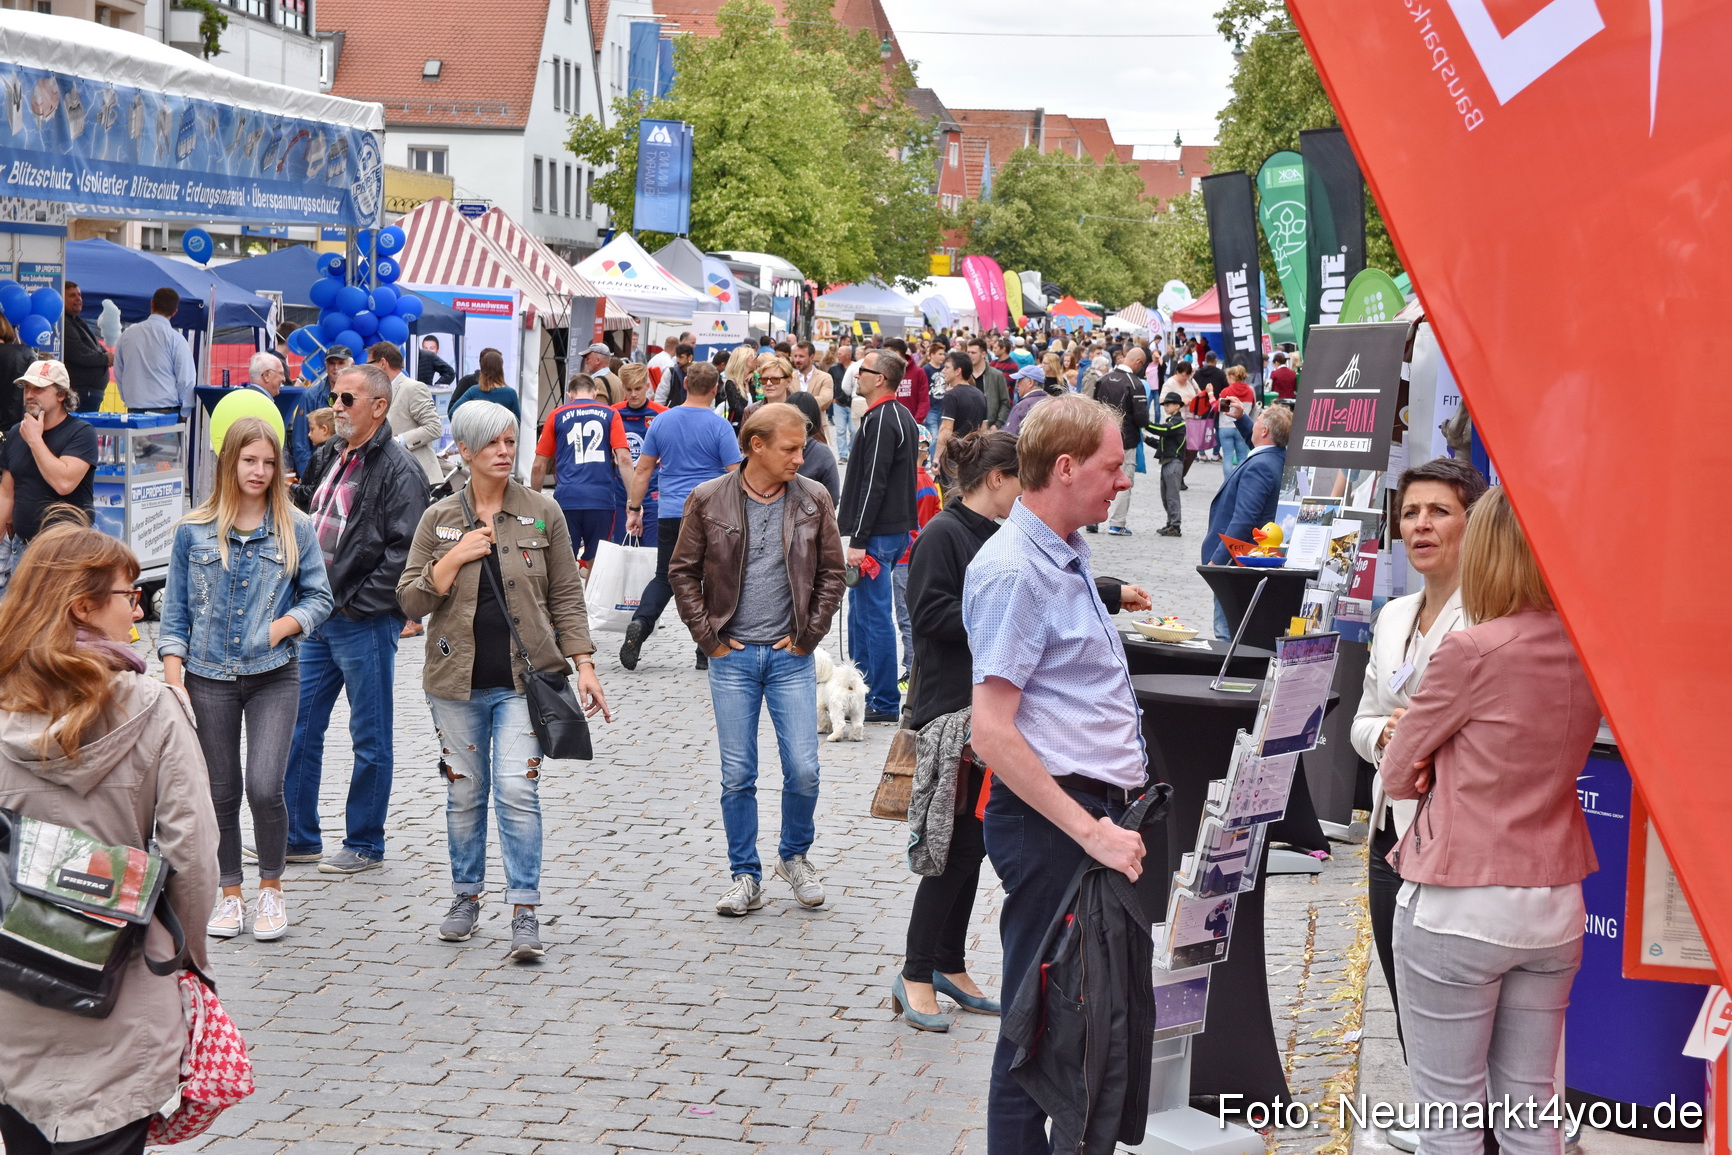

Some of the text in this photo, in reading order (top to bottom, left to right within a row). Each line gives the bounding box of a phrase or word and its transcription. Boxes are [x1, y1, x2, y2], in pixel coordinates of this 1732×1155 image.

[7, 160, 74, 190] Blitzschutz
[80, 169, 181, 200] Isolierter Blitzschutz
[185, 181, 246, 209] Erdungsmaterial
[252, 183, 341, 216] Überspannungsschutz
[456, 300, 470, 308] DAS
[471, 301, 510, 310] HANDWERK
[562, 408, 608, 424] ASV Neumarkt
[566, 419, 606, 465] 12
[1304, 438, 1368, 450] ZEITARBEIT
[438, 528, 463, 541] WHY
[63, 875, 107, 890] FREITAG
